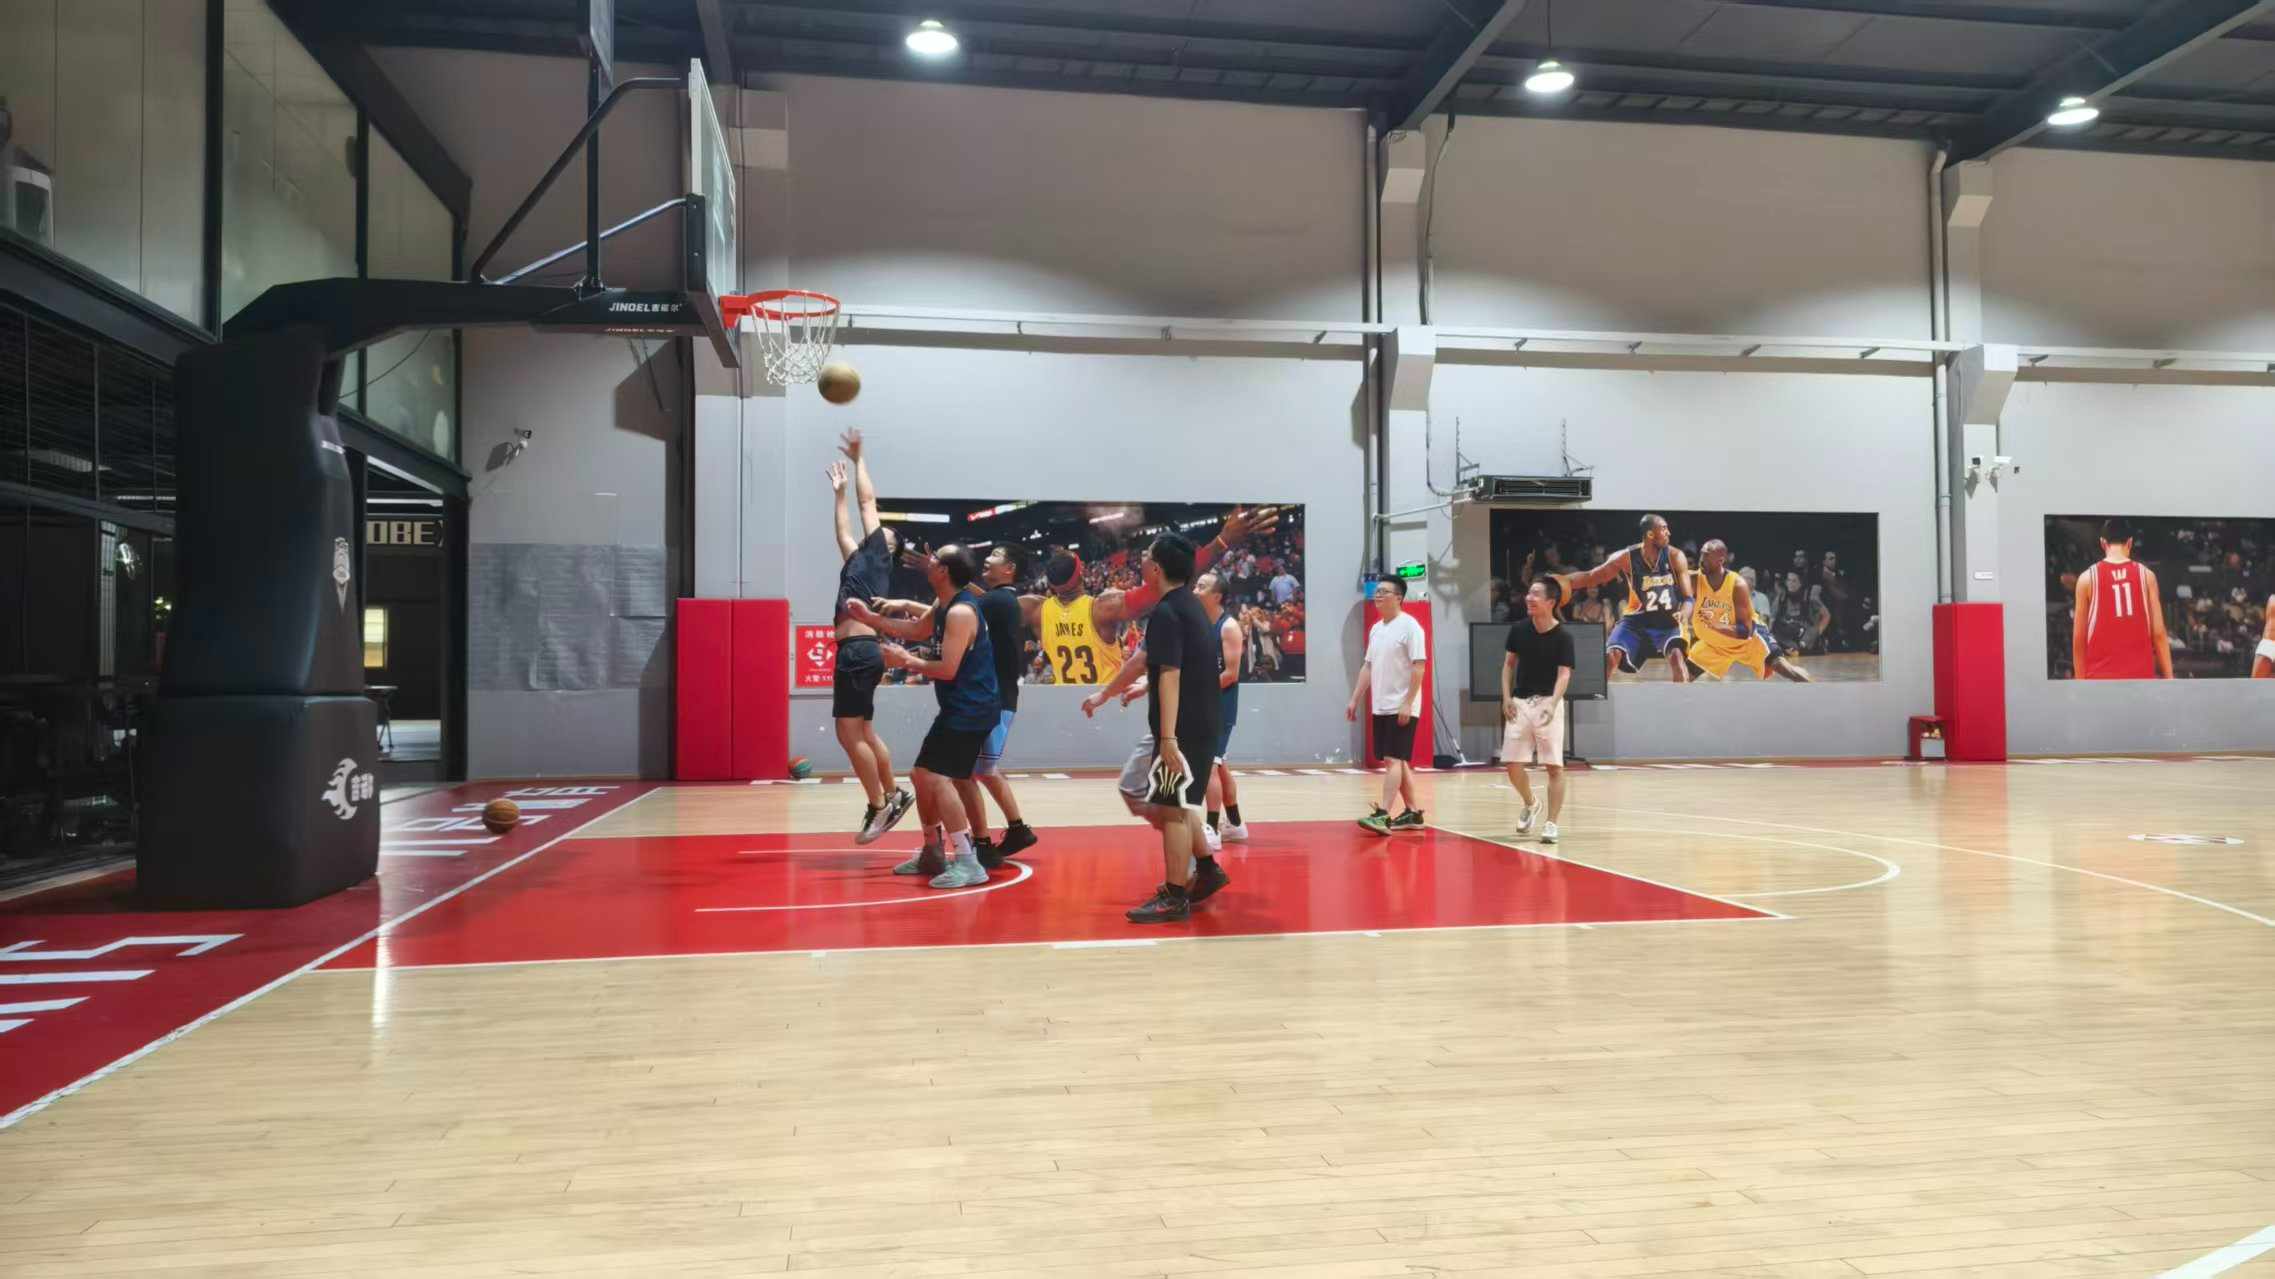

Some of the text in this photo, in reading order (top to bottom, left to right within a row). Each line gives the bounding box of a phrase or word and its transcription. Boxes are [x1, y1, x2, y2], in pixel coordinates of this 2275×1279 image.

[1646, 589, 1672, 612] 24
[2111, 582, 2134, 618] 11
[1056, 623, 1084, 637] JAMES
[1057, 645, 1098, 684] 23
